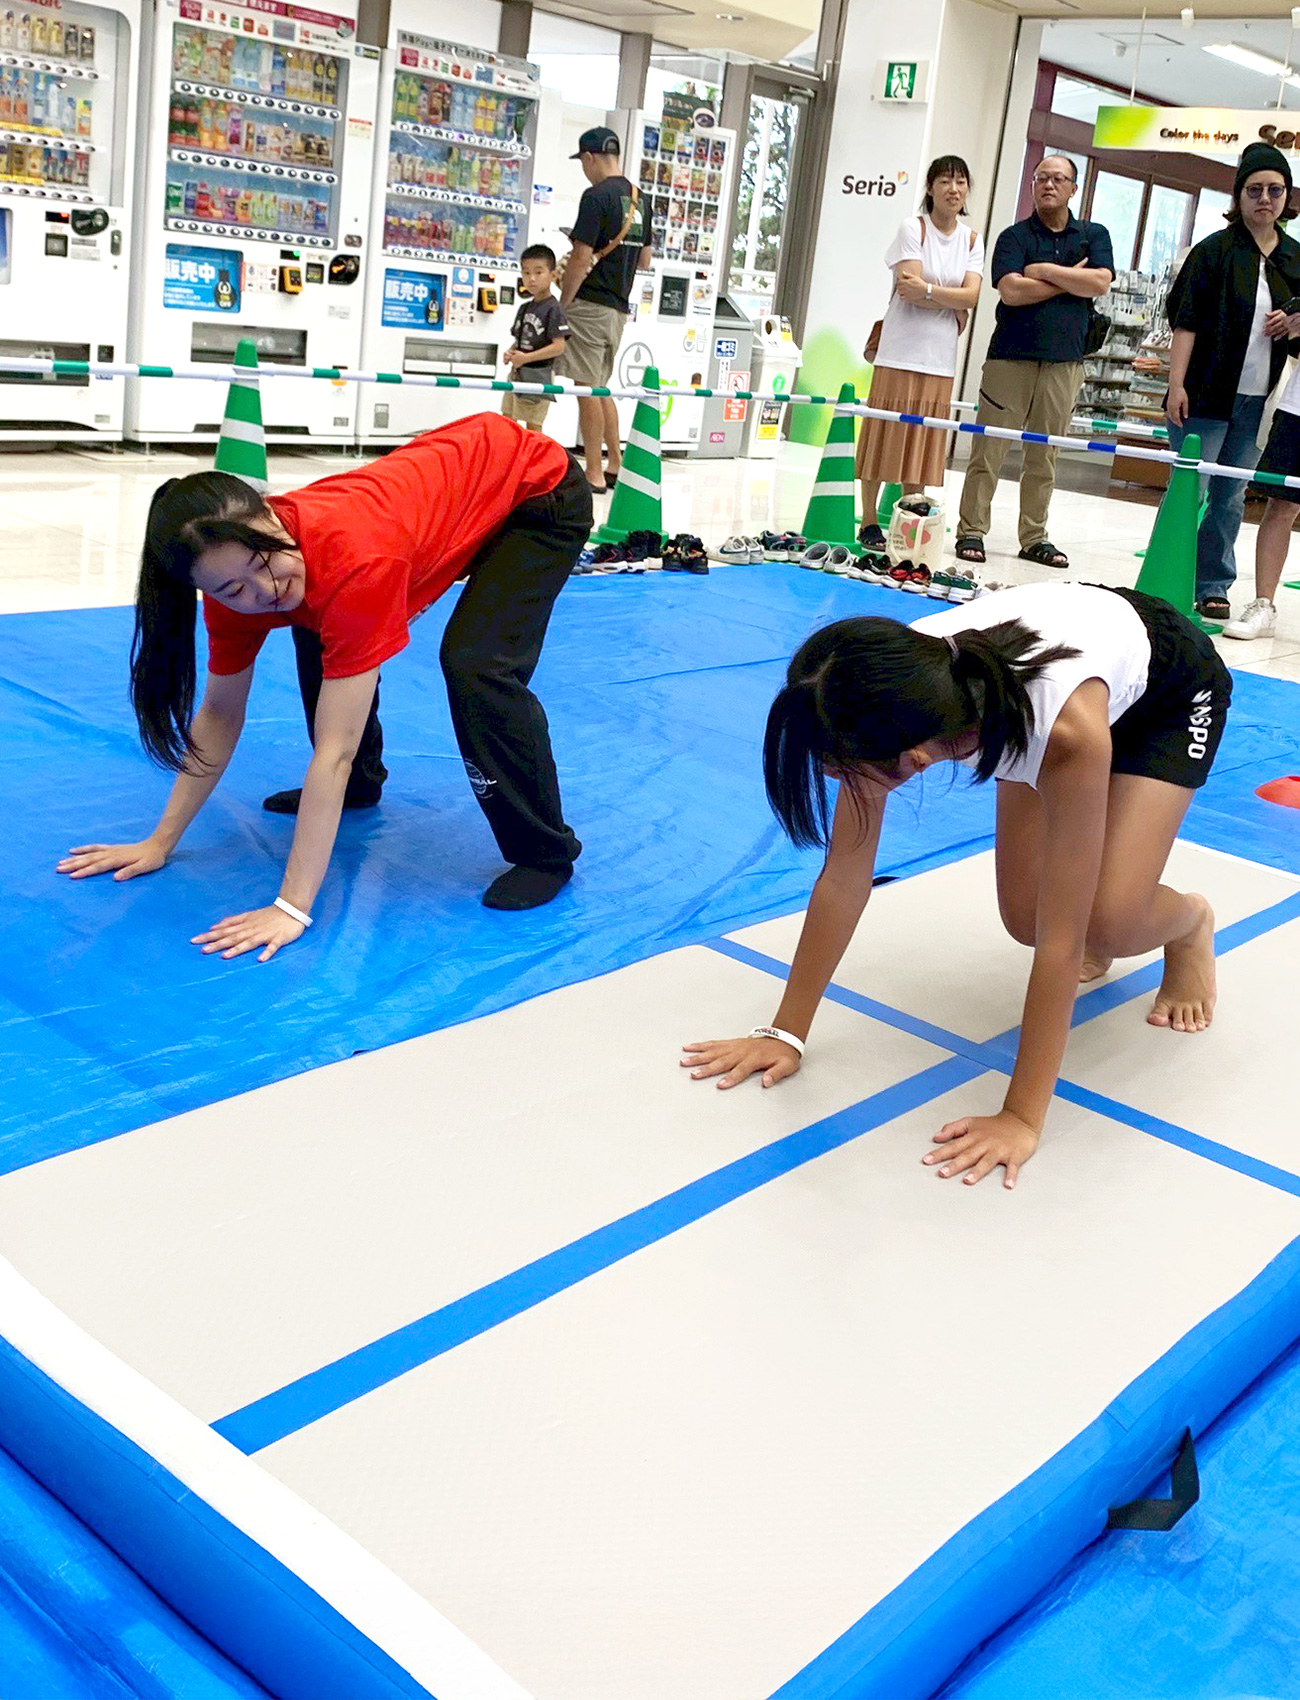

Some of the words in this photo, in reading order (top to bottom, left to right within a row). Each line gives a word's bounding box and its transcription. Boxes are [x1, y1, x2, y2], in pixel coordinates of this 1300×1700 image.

[1160, 127, 1190, 139] Color
[1192, 129, 1210, 140] the
[1213, 130, 1239, 142] days
[842, 174, 897, 197] Seria
[165, 259, 216, 283] 販売中
[384, 279, 429, 302] 販売中
